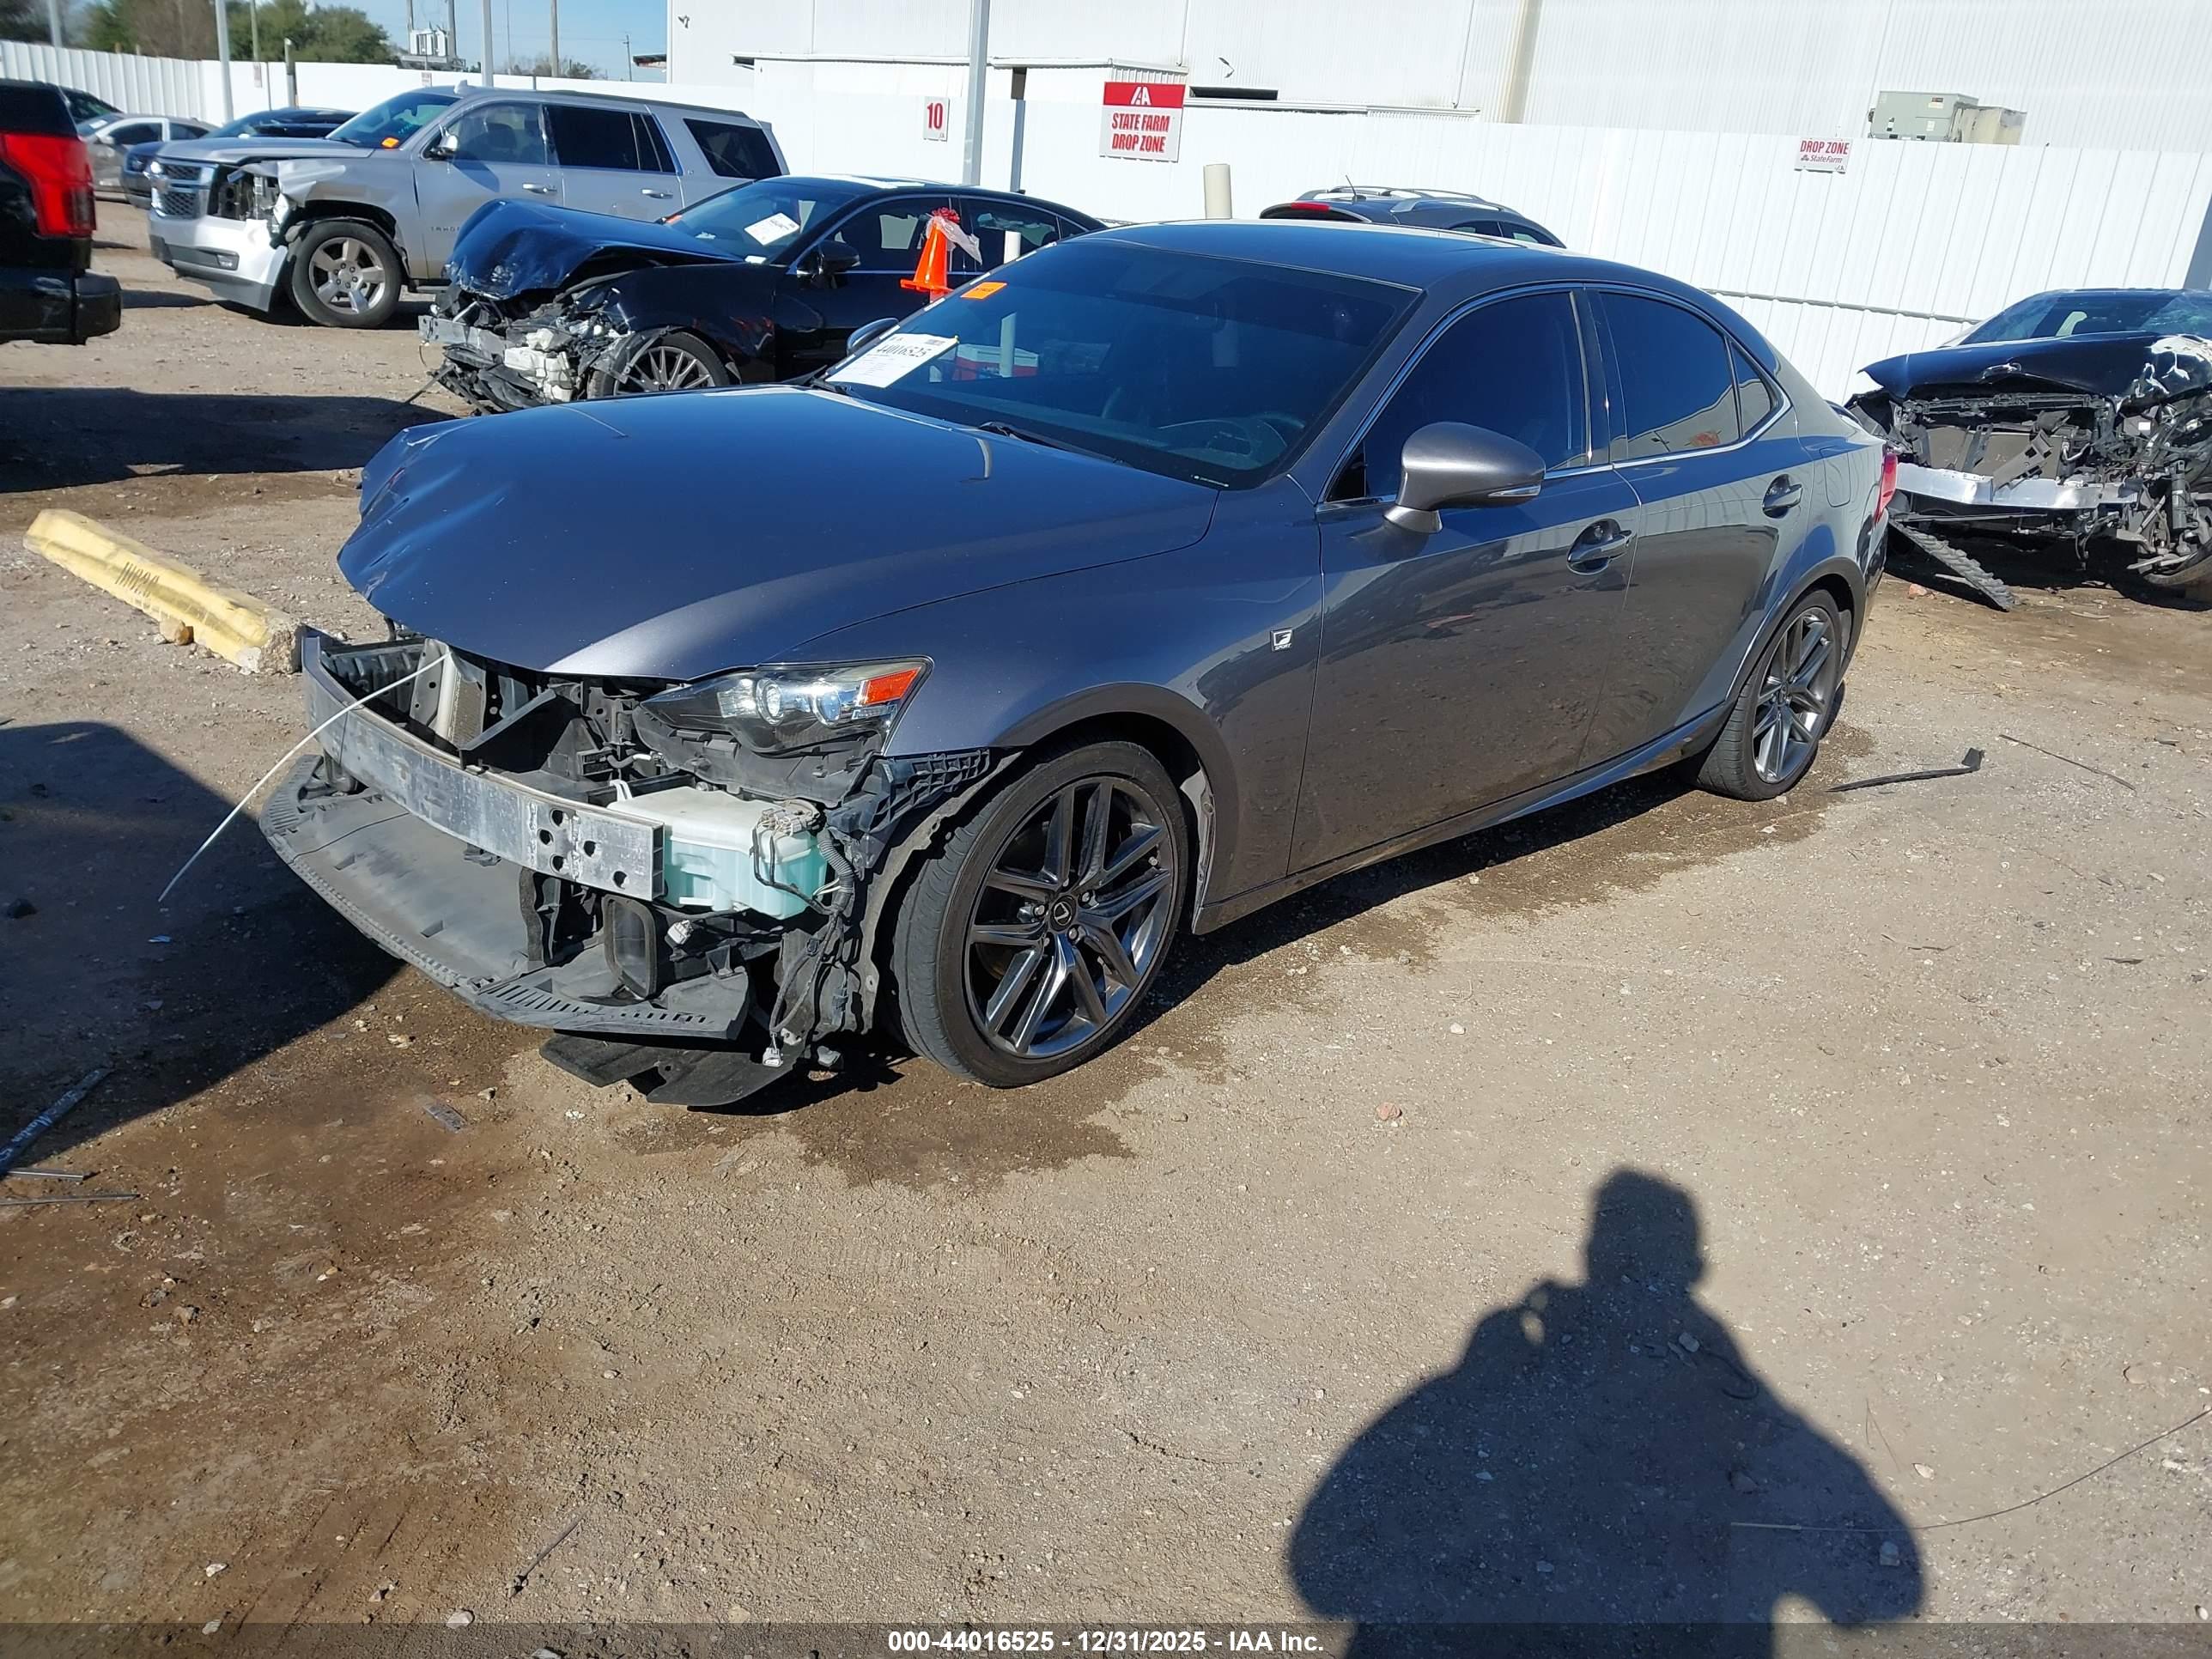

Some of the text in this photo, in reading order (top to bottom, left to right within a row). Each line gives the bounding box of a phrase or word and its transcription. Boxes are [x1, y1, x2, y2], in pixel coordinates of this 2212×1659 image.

[927, 102, 944, 130] 10
[1111, 112, 1170, 132] STATE FARM
[1111, 133, 1167, 154] DROP ZONE
[1800, 140, 1850, 155] DROP ZONE
